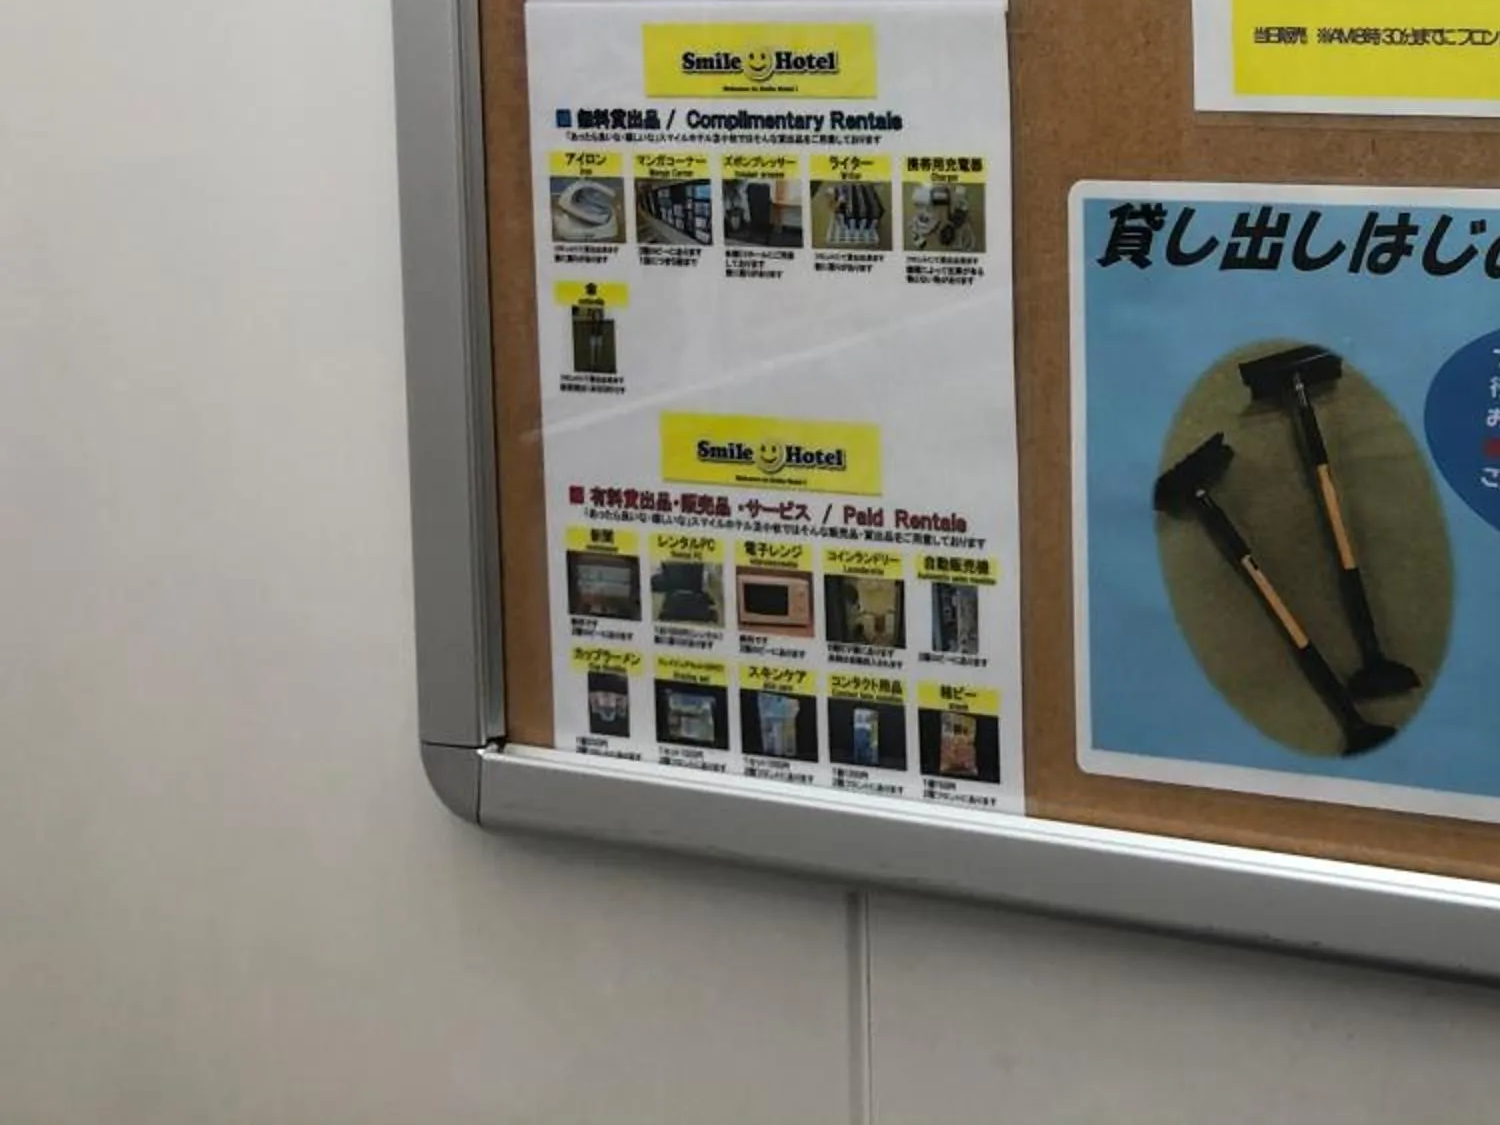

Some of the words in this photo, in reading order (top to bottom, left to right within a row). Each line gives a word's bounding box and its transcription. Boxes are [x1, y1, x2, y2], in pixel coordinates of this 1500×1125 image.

[682, 50, 743, 74] Smile
[774, 49, 839, 74] Hotel
[687, 110, 824, 134] Complimentary
[565, 152, 608, 166] アイロン
[636, 155, 707, 167] マンガコーナー
[829, 156, 873, 170] ライター
[697, 441, 753, 462] Smile
[784, 445, 845, 468] Hotel
[843, 505, 884, 526] Paid
[744, 540, 804, 559] 電子レンジ
